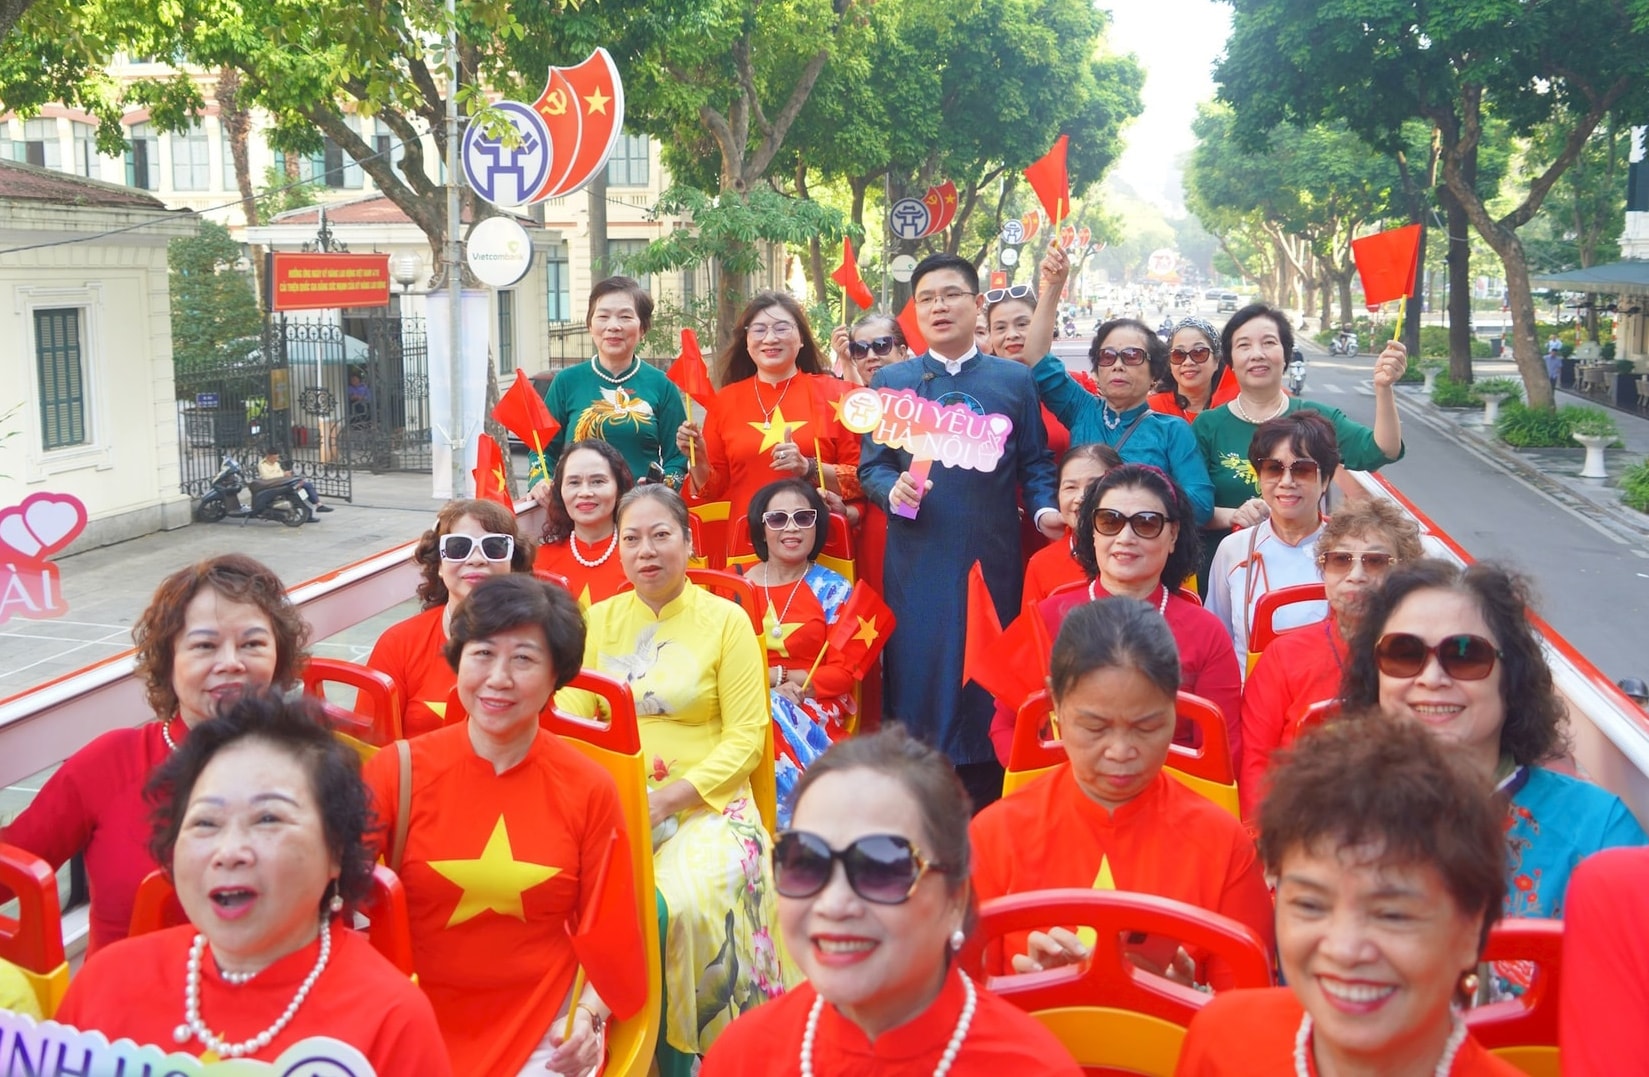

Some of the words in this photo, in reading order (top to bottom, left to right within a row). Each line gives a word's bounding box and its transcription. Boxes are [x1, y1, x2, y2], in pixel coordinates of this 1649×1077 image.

[881, 393, 924, 423] TÔI
[931, 406, 986, 439] YÊU
[877, 419, 914, 448] HÀ
[922, 431, 971, 464] NỘI
